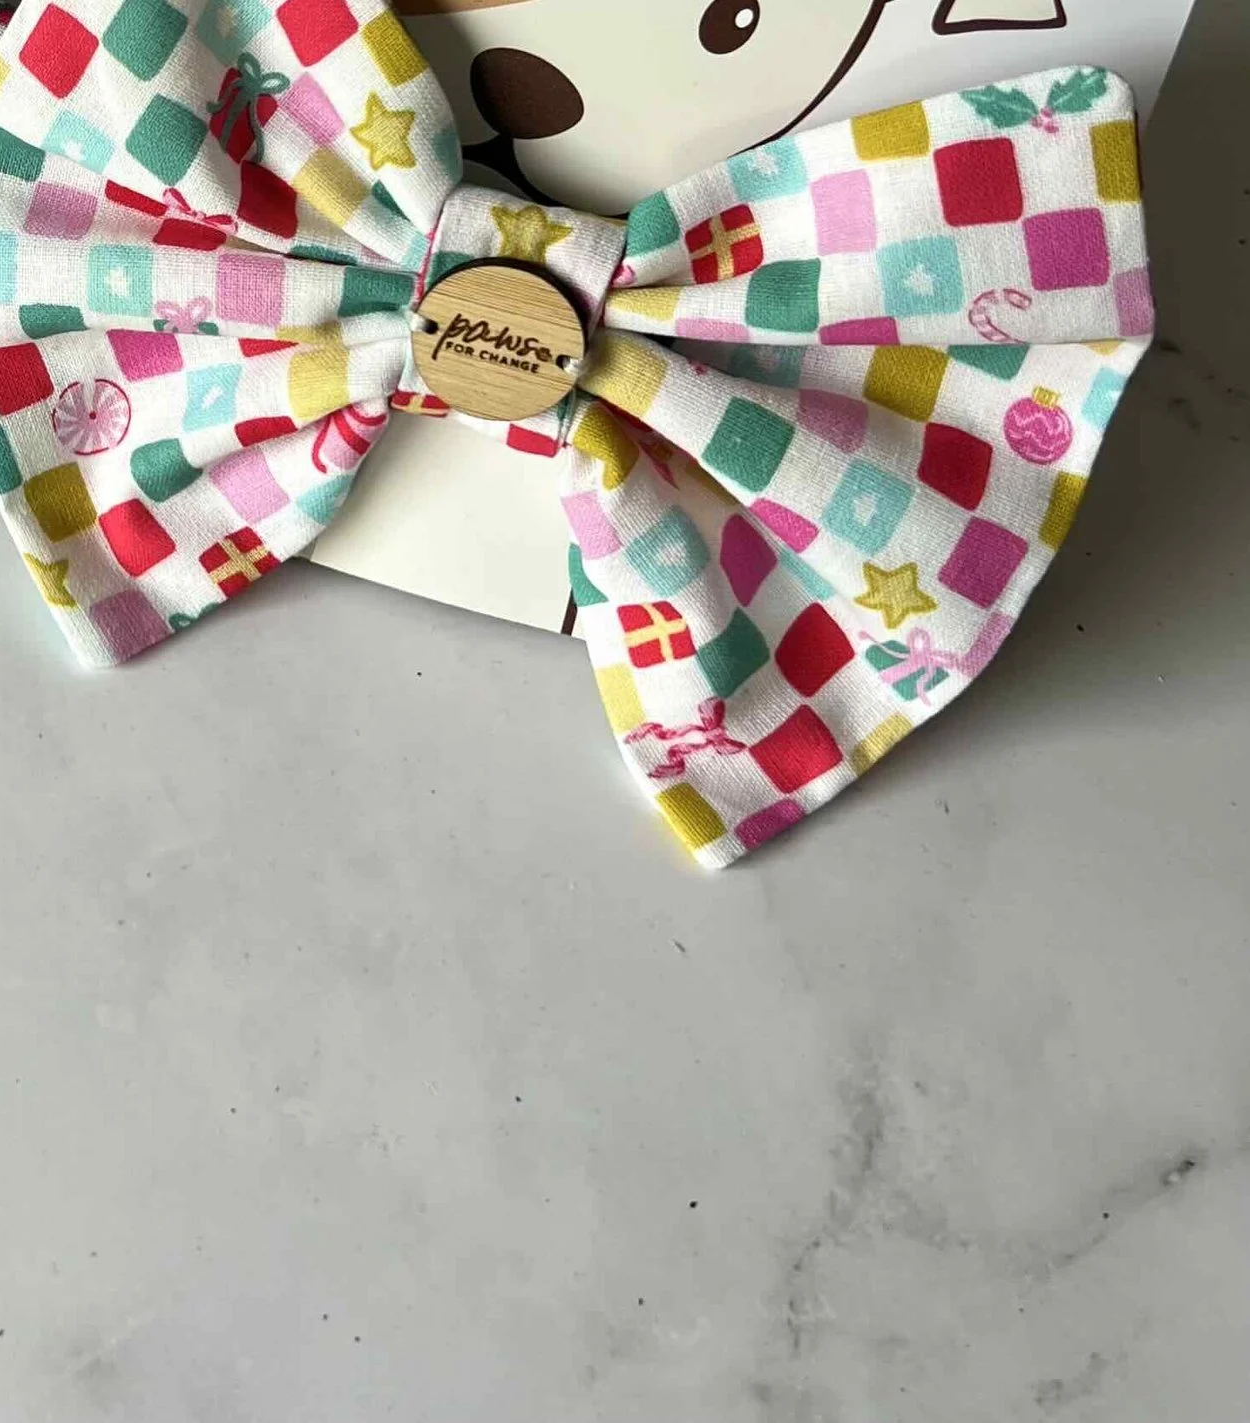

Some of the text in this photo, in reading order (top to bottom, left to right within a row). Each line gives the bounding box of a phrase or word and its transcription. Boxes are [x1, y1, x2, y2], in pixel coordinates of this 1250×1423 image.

[431, 313, 540, 361] paws
[445, 340, 541, 375] FOR CHANGE
